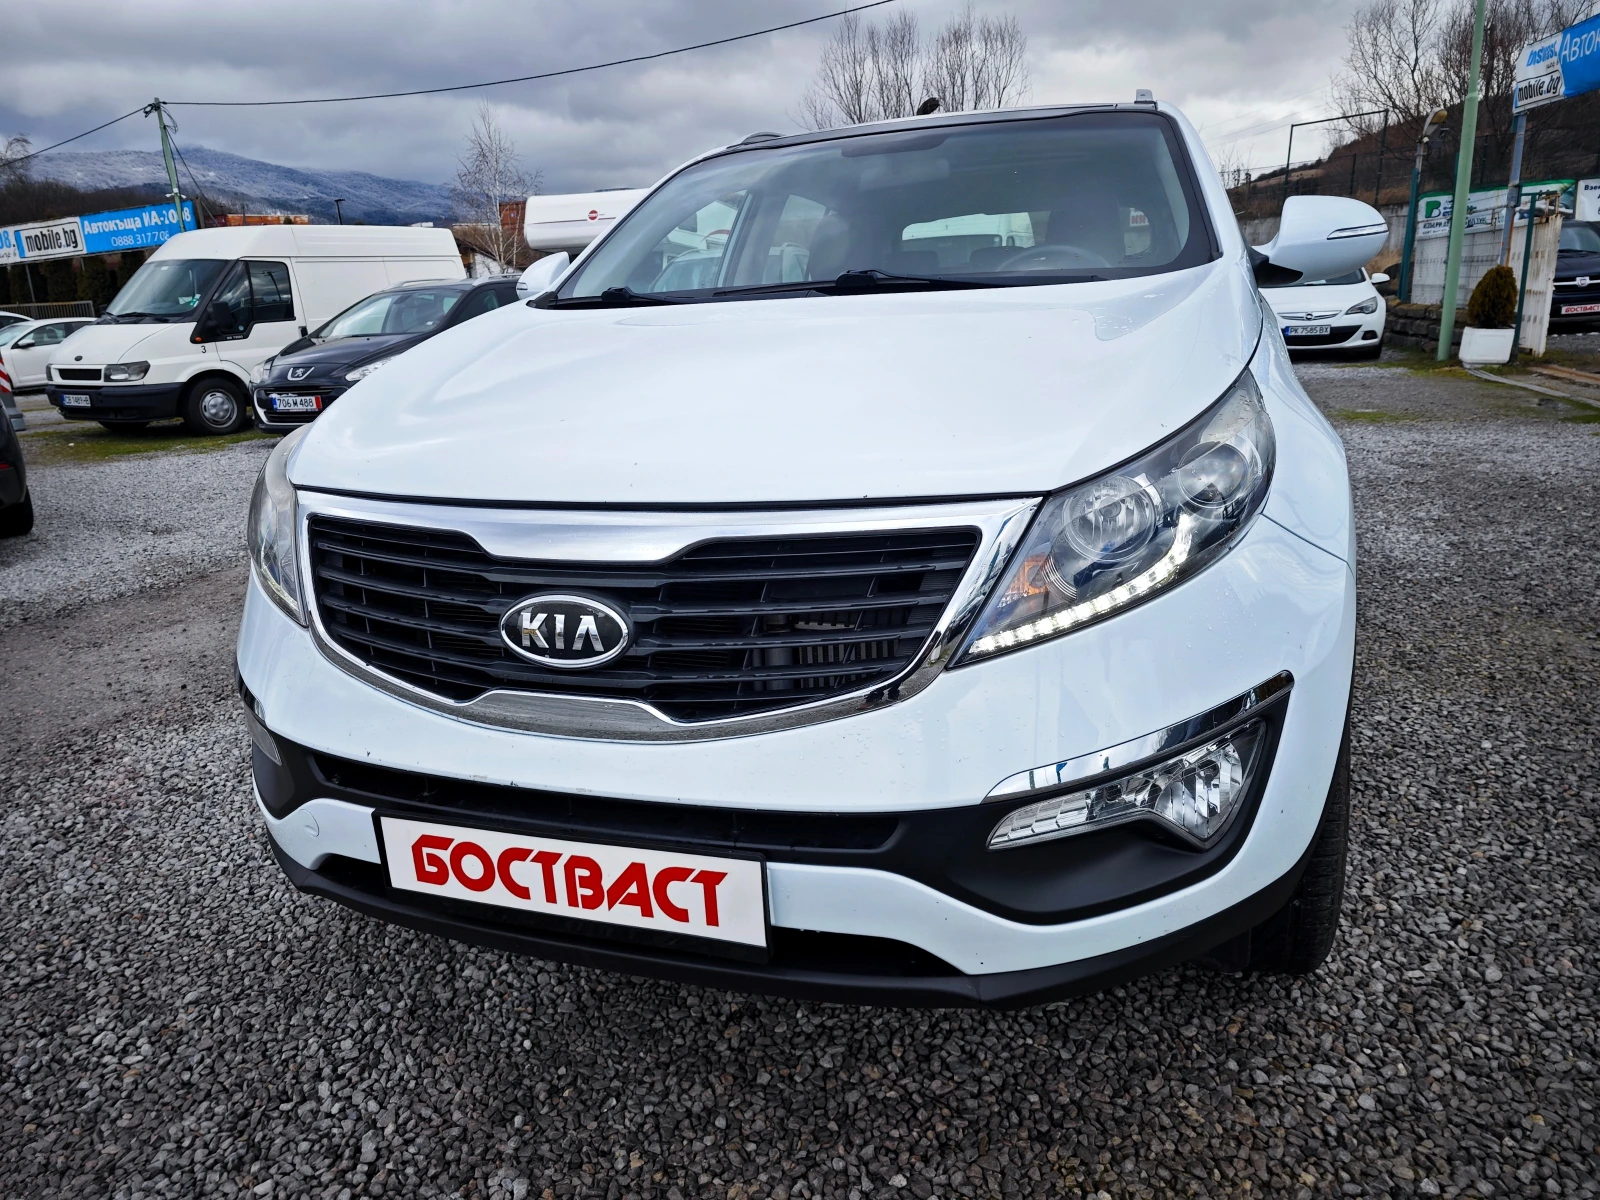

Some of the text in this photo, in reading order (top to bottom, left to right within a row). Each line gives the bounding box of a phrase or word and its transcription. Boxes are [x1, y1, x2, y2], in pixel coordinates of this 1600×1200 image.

[1518, 75, 1560, 102] mobile.bg
[84, 207, 191, 235] Автокъща ИА-208
[25, 227, 79, 252] mobile.bg
[111, 235, 134, 247] 0888
[201, 345, 207, 354] 3
[277, 398, 292, 408] 706
[299, 398, 314, 408] 488
[521, 612, 604, 652] KIA
[411, 834, 728, 928] БОСТВАСТ
